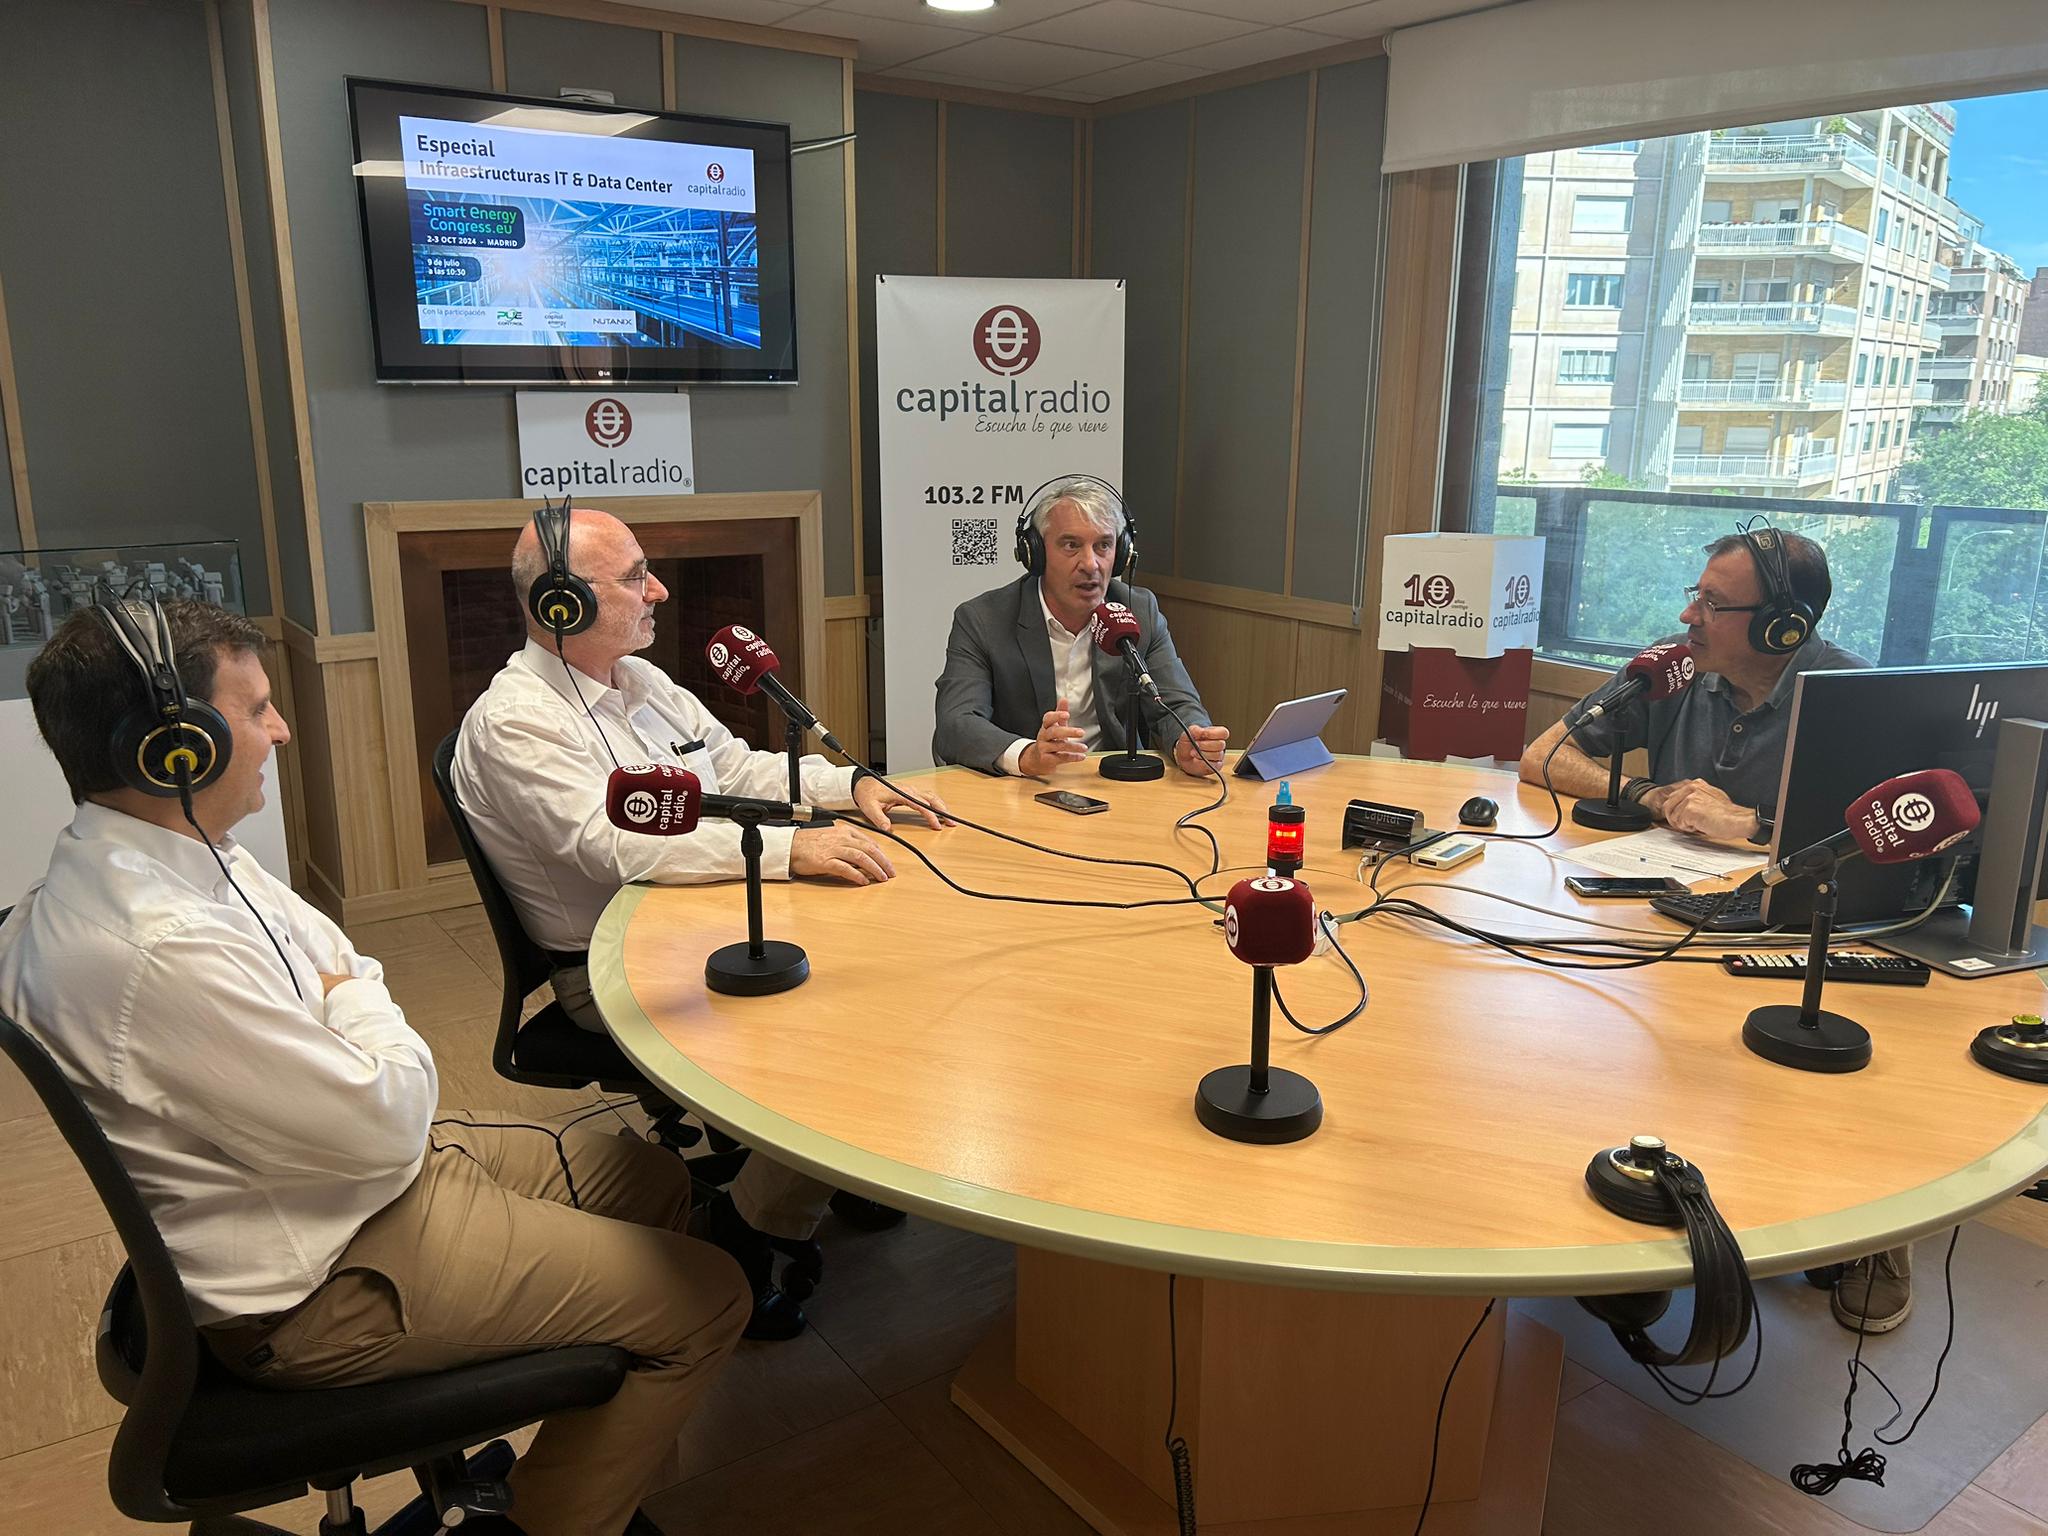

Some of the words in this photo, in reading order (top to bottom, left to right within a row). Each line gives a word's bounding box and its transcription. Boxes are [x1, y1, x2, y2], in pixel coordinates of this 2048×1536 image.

[416, 134, 496, 158] Especial
[419, 159, 551, 184] Infraestructuras
[554, 171, 569, 186] IT
[572, 172, 584, 187] &
[587, 173, 622, 191] Data
[625, 176, 673, 194] Center
[687, 183, 746, 197] capitalradio
[423, 203, 467, 218] Smart
[430, 217, 513, 235] Congress.eu
[426, 235, 440, 244] 2-3
[441, 236, 457, 244] OCT
[458, 236, 477, 245] 2024
[487, 238, 518, 247] MADRID
[427, 258, 433, 267] 9
[433, 258, 443, 267] de
[434, 267, 445, 276] las
[446, 268, 466, 277] 10:30
[422, 308, 436, 316] Con
[436, 308, 443, 316] la
[444, 309, 486, 318] participación
[592, 318, 632, 326] NUTANIX
[896, 379, 1111, 422] capitalradio
[974, 412, 1027, 433] Escucha
[1031, 412, 1045, 433] lo
[1049, 420, 1074, 440] que
[1078, 419, 1109, 433] viene
[924, 485, 985, 504] 103.2
[990, 485, 1024, 504] FM
[1386, 609, 1484, 628] capitalradio
[721, 654, 742, 681] capital
[1671, 660, 1684, 690] capital
[1422, 691, 1465, 709] Escucha
[1467, 693, 1479, 709] lo
[1481, 699, 1500, 714] que
[1503, 699, 1528, 709] viene
[1966, 683, 1999, 739] hp
[659, 789, 674, 831] capital
[1871, 800, 1906, 848] capital
